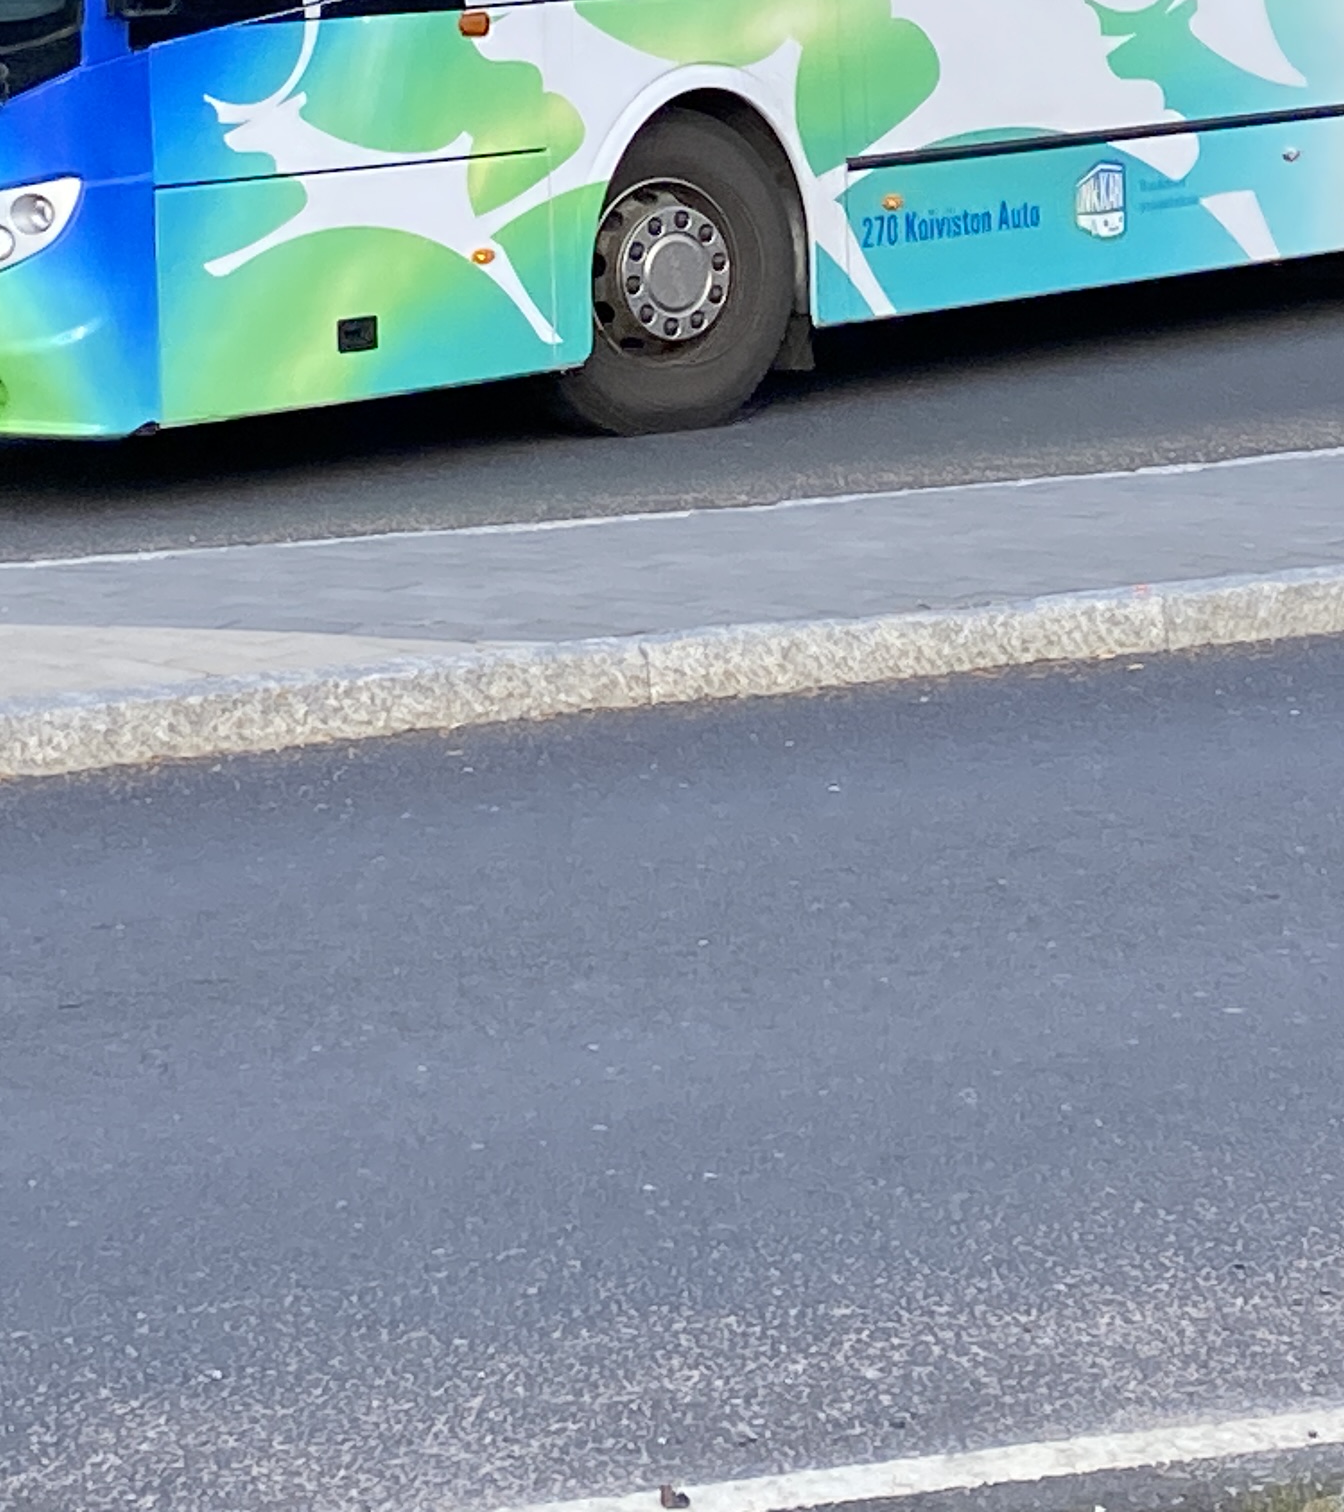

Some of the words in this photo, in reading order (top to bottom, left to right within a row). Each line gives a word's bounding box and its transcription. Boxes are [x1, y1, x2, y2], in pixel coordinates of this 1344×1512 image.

[862, 214, 899, 248] 270
[905, 209, 993, 243] Koiviston
[998, 200, 1041, 231] Auto
